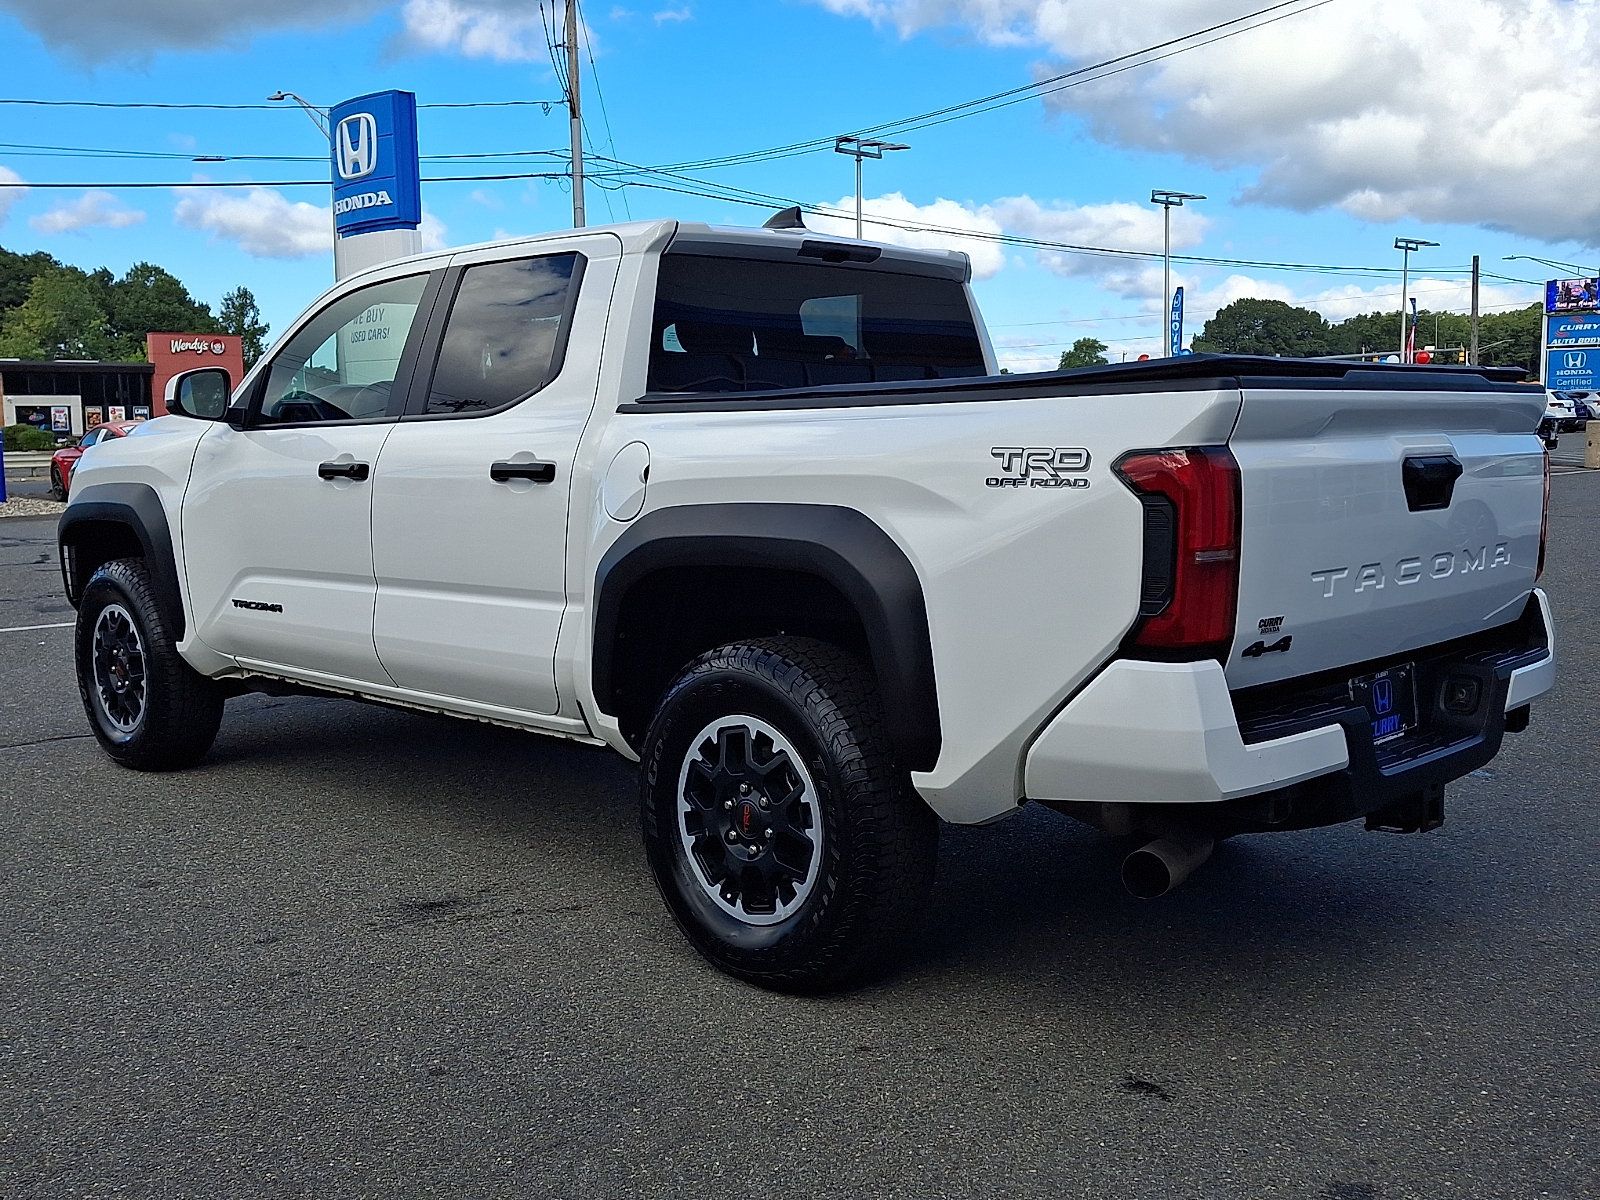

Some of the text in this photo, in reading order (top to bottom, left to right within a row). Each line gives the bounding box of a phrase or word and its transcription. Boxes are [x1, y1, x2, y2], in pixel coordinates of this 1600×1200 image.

[334, 190, 393, 216] HONDA
[366, 308, 385, 323] BUY
[1560, 323, 1600, 331] CURRY
[350, 327, 391, 343] USED CARS!
[171, 337, 209, 354] Wendy's
[1556, 378, 1592, 386] Certified
[990, 446, 1092, 478] TRD
[985, 477, 1091, 490] OFF ROAD
[1311, 542, 1511, 598] TACOMA
[231, 598, 284, 614] TACOMA
[1258, 615, 1285, 629] CURRY
[1260, 626, 1281, 635] HONDA
